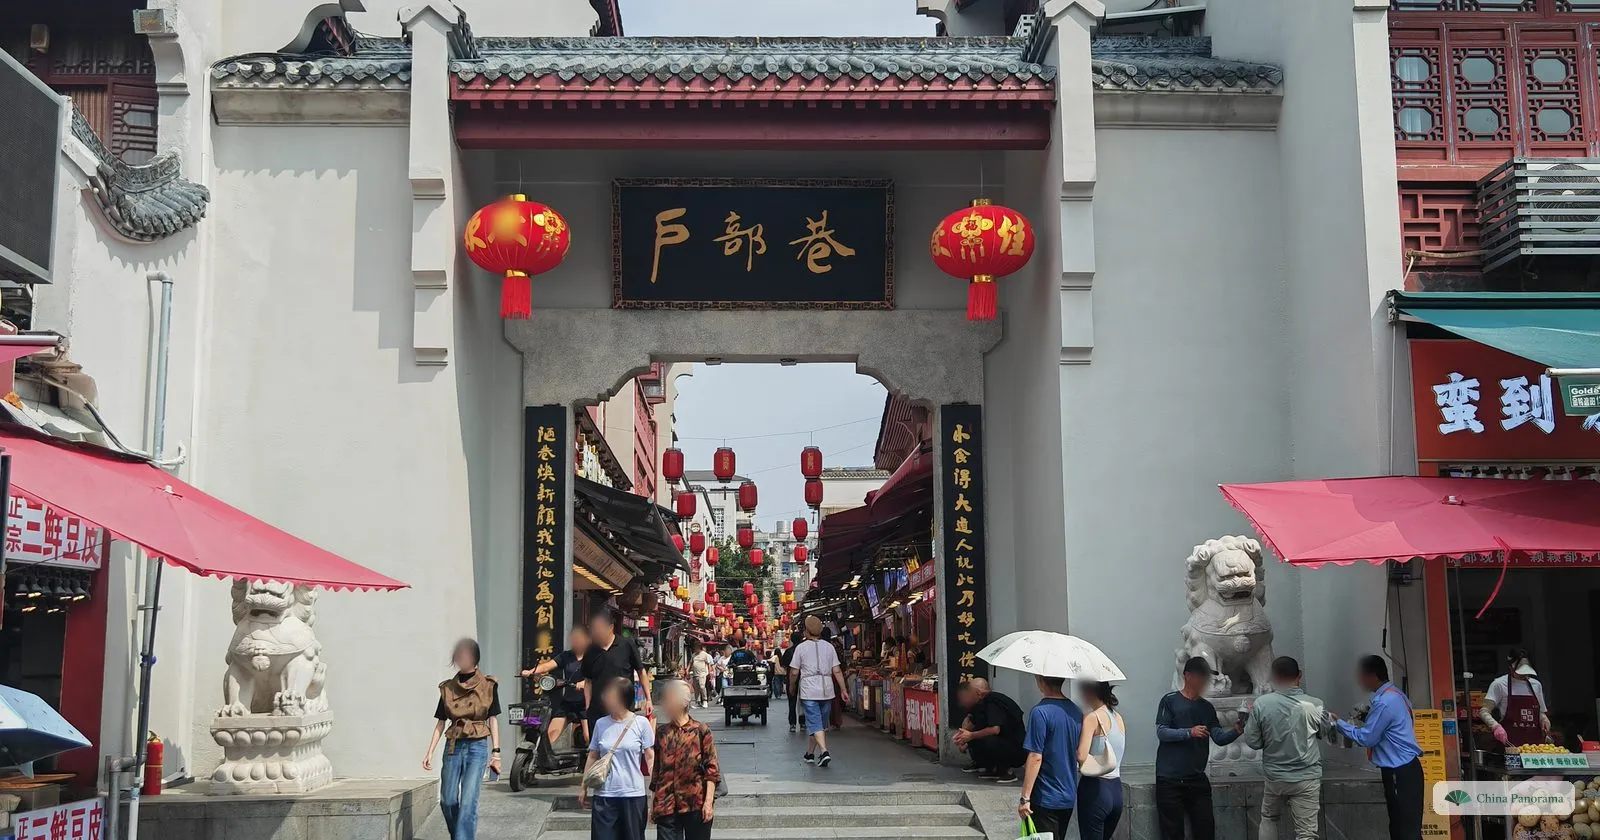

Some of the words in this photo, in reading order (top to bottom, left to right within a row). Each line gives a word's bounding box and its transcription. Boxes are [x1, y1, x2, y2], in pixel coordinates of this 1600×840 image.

[1432, 371, 1600, 434] 蛮到
[23, 503, 100, 564] 三鲜豆皮
